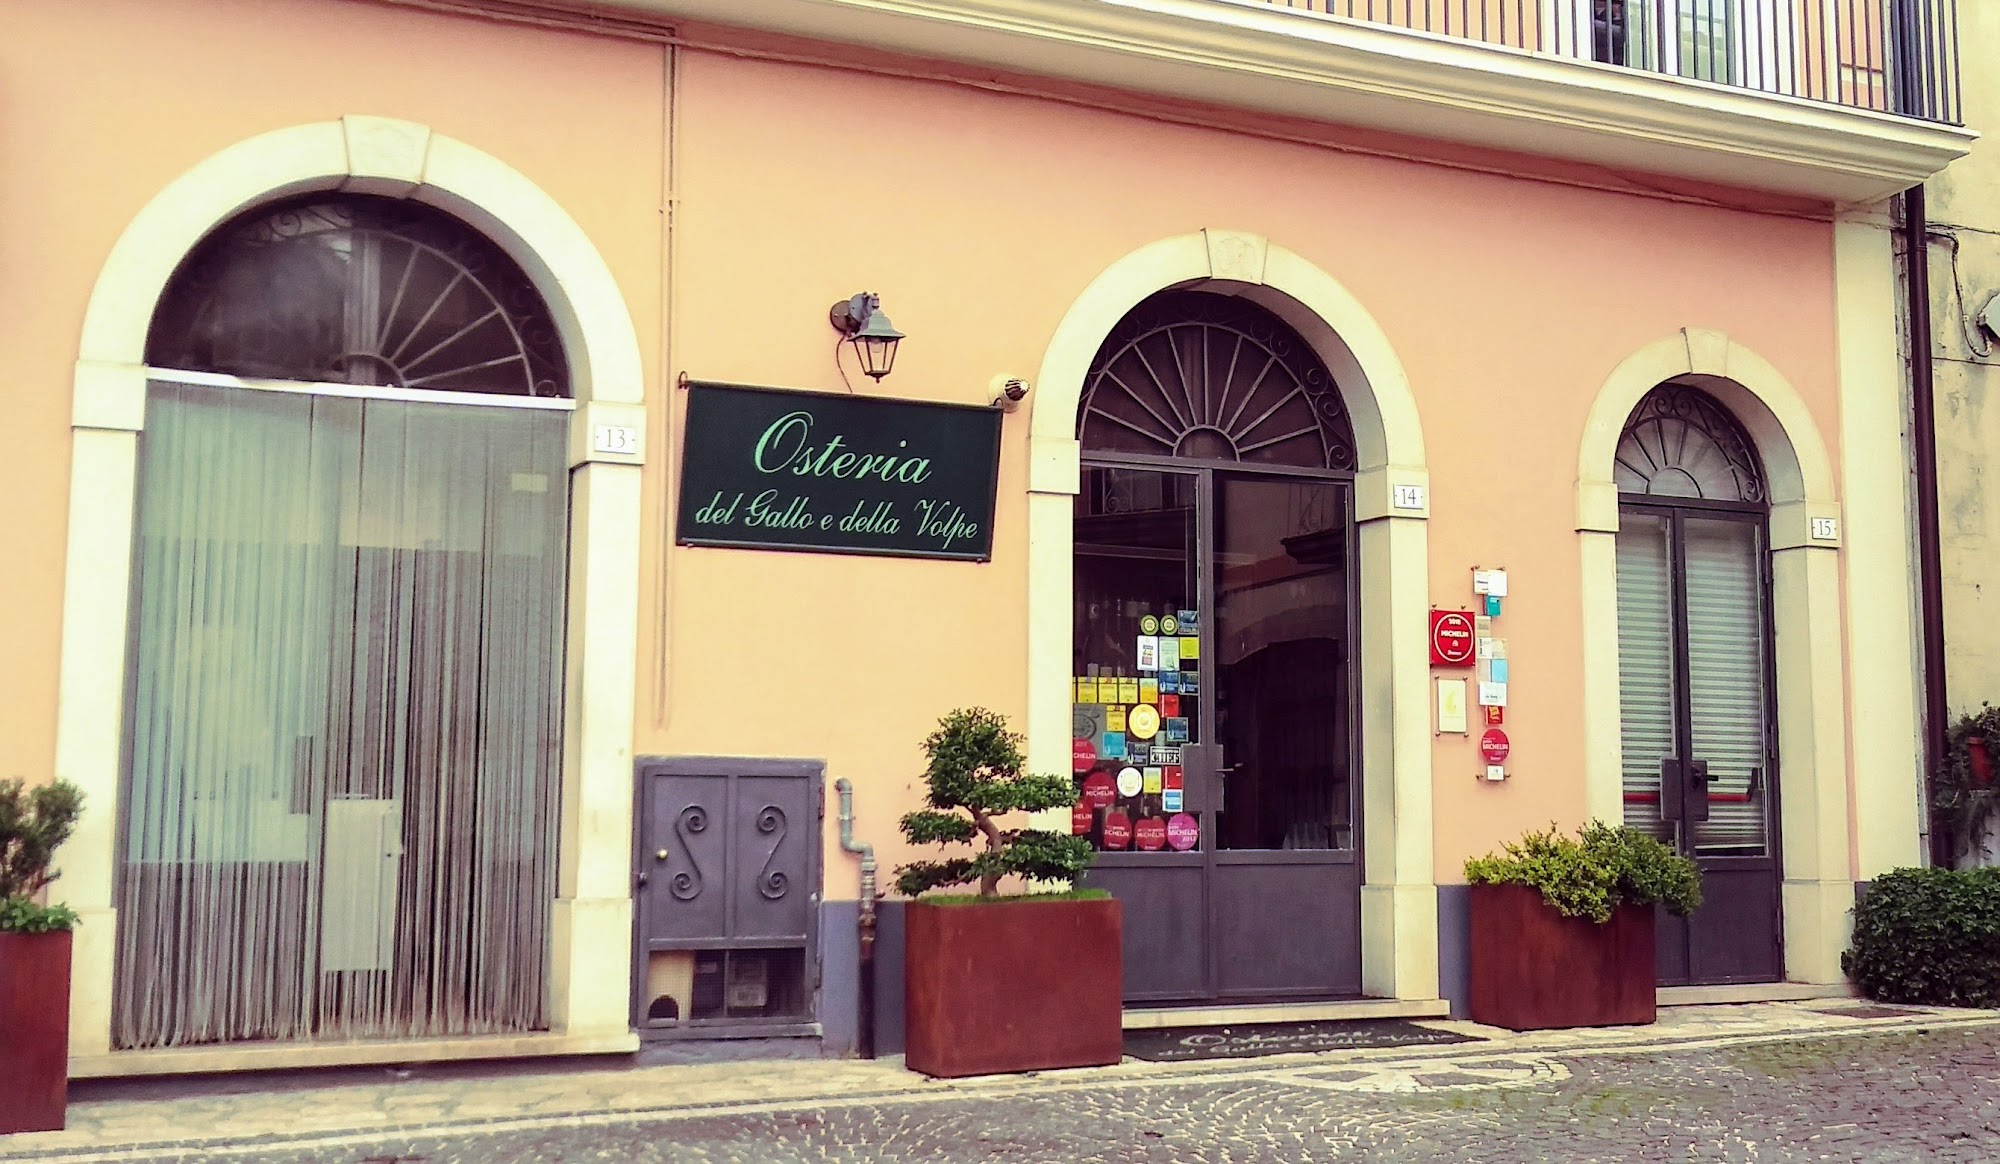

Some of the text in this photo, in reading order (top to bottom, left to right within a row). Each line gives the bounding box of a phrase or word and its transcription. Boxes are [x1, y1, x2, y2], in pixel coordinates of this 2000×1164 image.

[607, 429, 625, 448] 13
[754, 411, 932, 484] Osteria
[1402, 488, 1416, 505] 14
[695, 489, 979, 549] del Gallo e della Volpe
[1819, 520, 1831, 536] 15
[1441, 630, 1469, 638] MICHELIN
[1151, 753, 1180, 763] CHEF
[1086, 789, 1115, 797] MICHELIN
